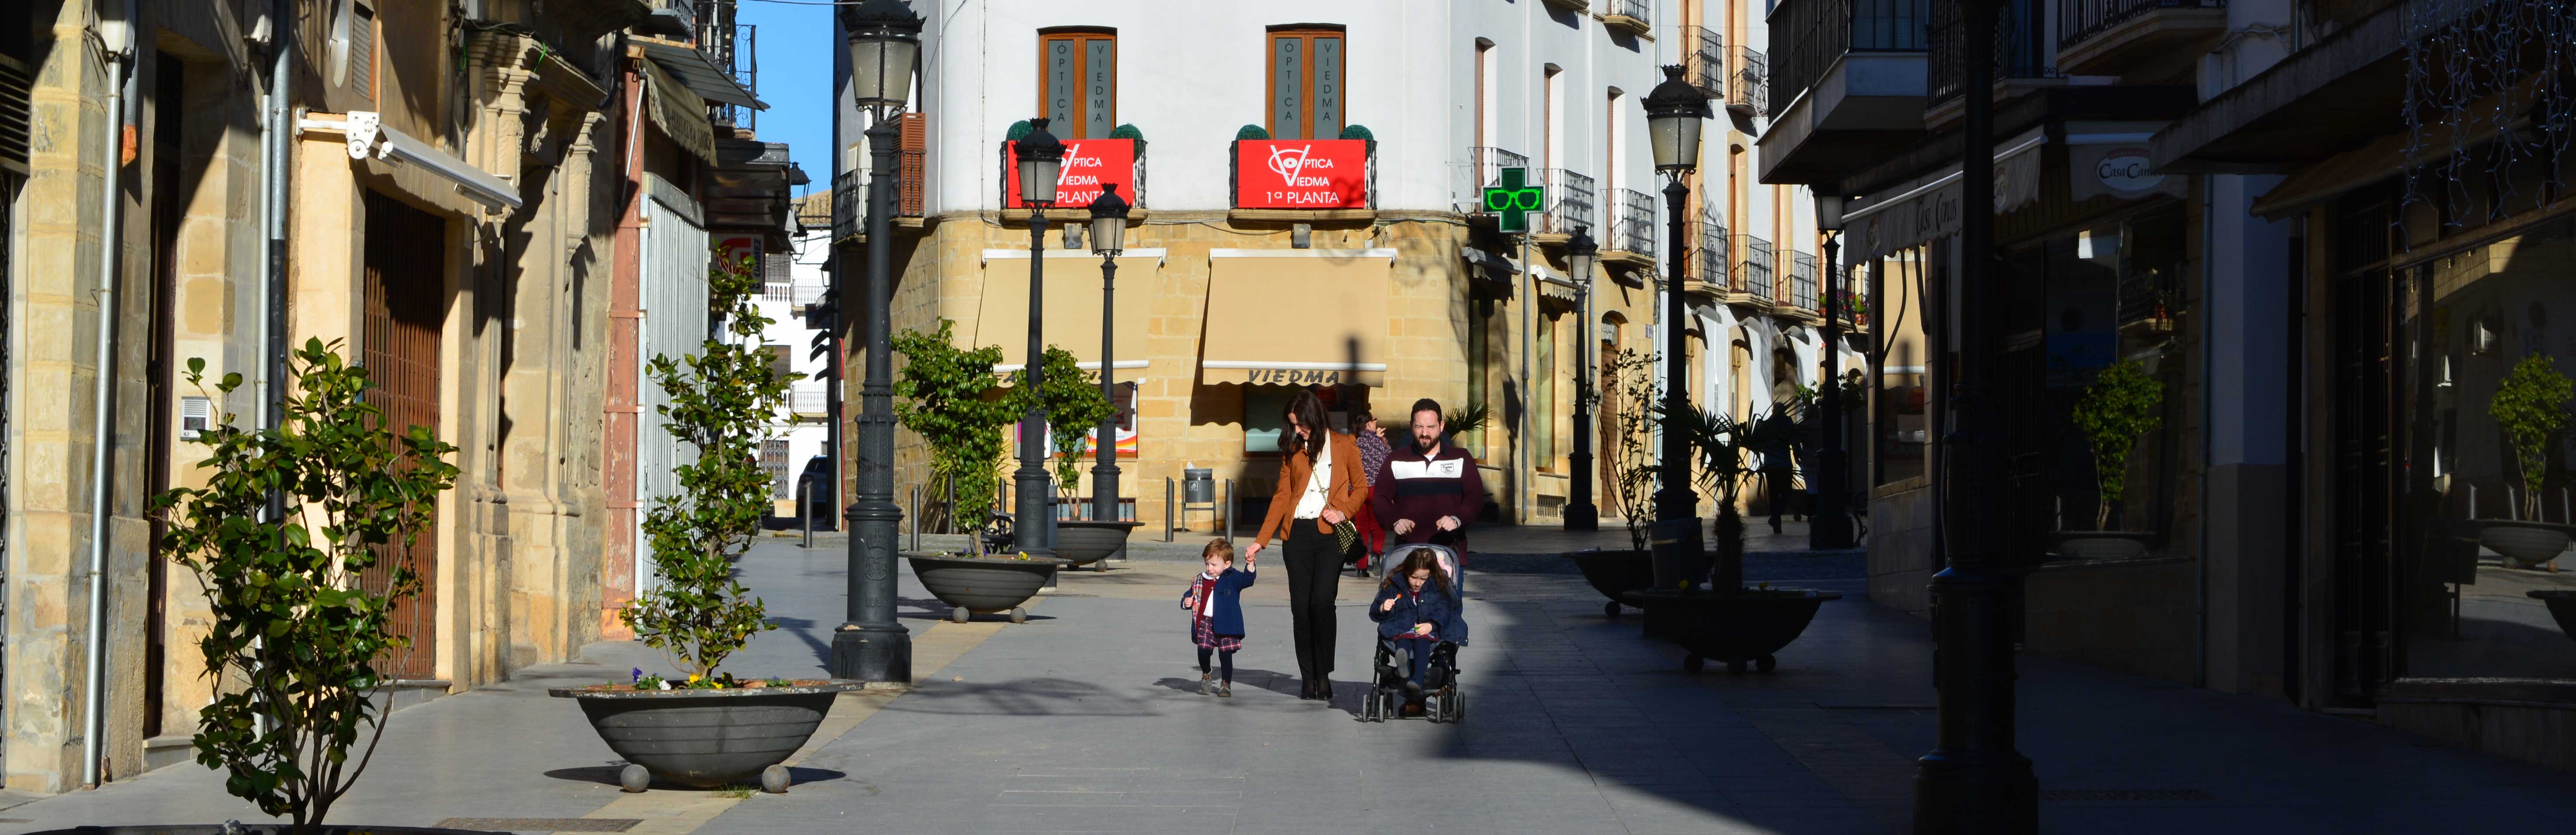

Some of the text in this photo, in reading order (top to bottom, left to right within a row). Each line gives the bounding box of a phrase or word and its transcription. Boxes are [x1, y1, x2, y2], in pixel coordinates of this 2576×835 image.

[1057, 42, 1066, 122] ÓPTICA
[1094, 45, 1104, 122] VIEDMA
[1285, 41, 1294, 121] ÓPTICA
[1323, 44, 1332, 121] VIEDMA
[1287, 191, 1340, 204] PLANTA
[2099, 163, 2125, 179] Casa
[1249, 369, 1339, 383] VIEDMA
